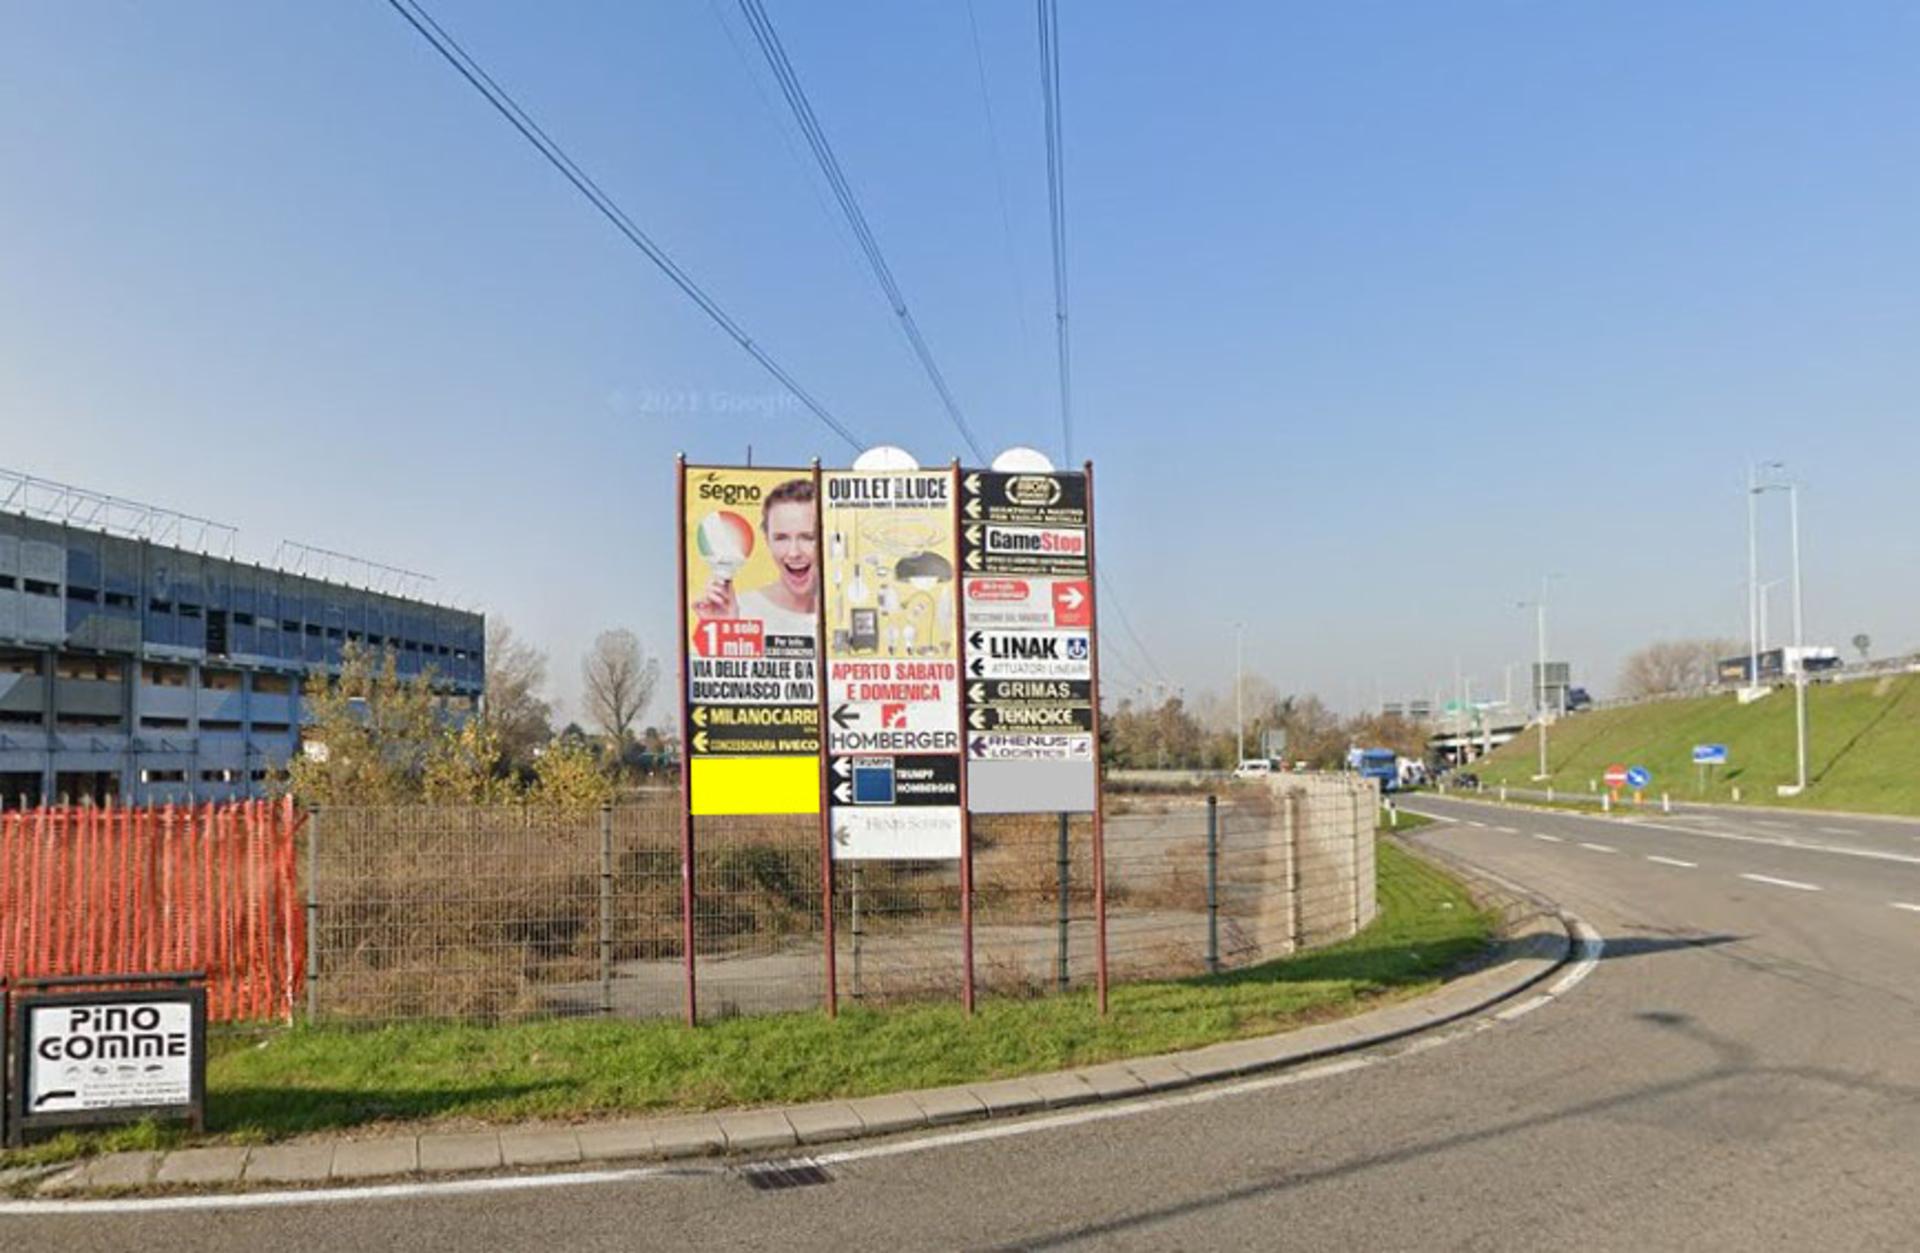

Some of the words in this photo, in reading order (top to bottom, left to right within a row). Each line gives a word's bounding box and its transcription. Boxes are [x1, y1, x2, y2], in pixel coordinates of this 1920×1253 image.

[699, 484, 761, 505] segno
[829, 477, 890, 499] OUTLET
[906, 477, 947, 499] LUCE
[989, 529, 1083, 554] GameStop
[734, 621, 761, 634] solo
[703, 622, 717, 656] 1
[723, 637, 761, 656] min.
[990, 637, 1059, 659] LINAK
[693, 661, 712, 678] VIA
[715, 661, 748, 678] DELLE
[751, 661, 790, 679] AZALEE
[832, 664, 891, 680] APERTO
[895, 664, 955, 680] SABATO
[693, 681, 780, 699] BUCCINASCO
[784, 681, 814, 700] (MI)
[847, 684, 856, 700] E
[860, 684, 940, 700] DOMENICA
[997, 682, 1071, 698] GRIMAS
[710, 708, 818, 725] MILANOCARRI
[779, 740, 819, 751] IVECO
[832, 732, 957, 749] HOMBERGER
[989, 736, 1069, 746] RHENUS
[896, 783, 957, 793] HOMBERGER
[38, 1033, 187, 1060] GOMME
